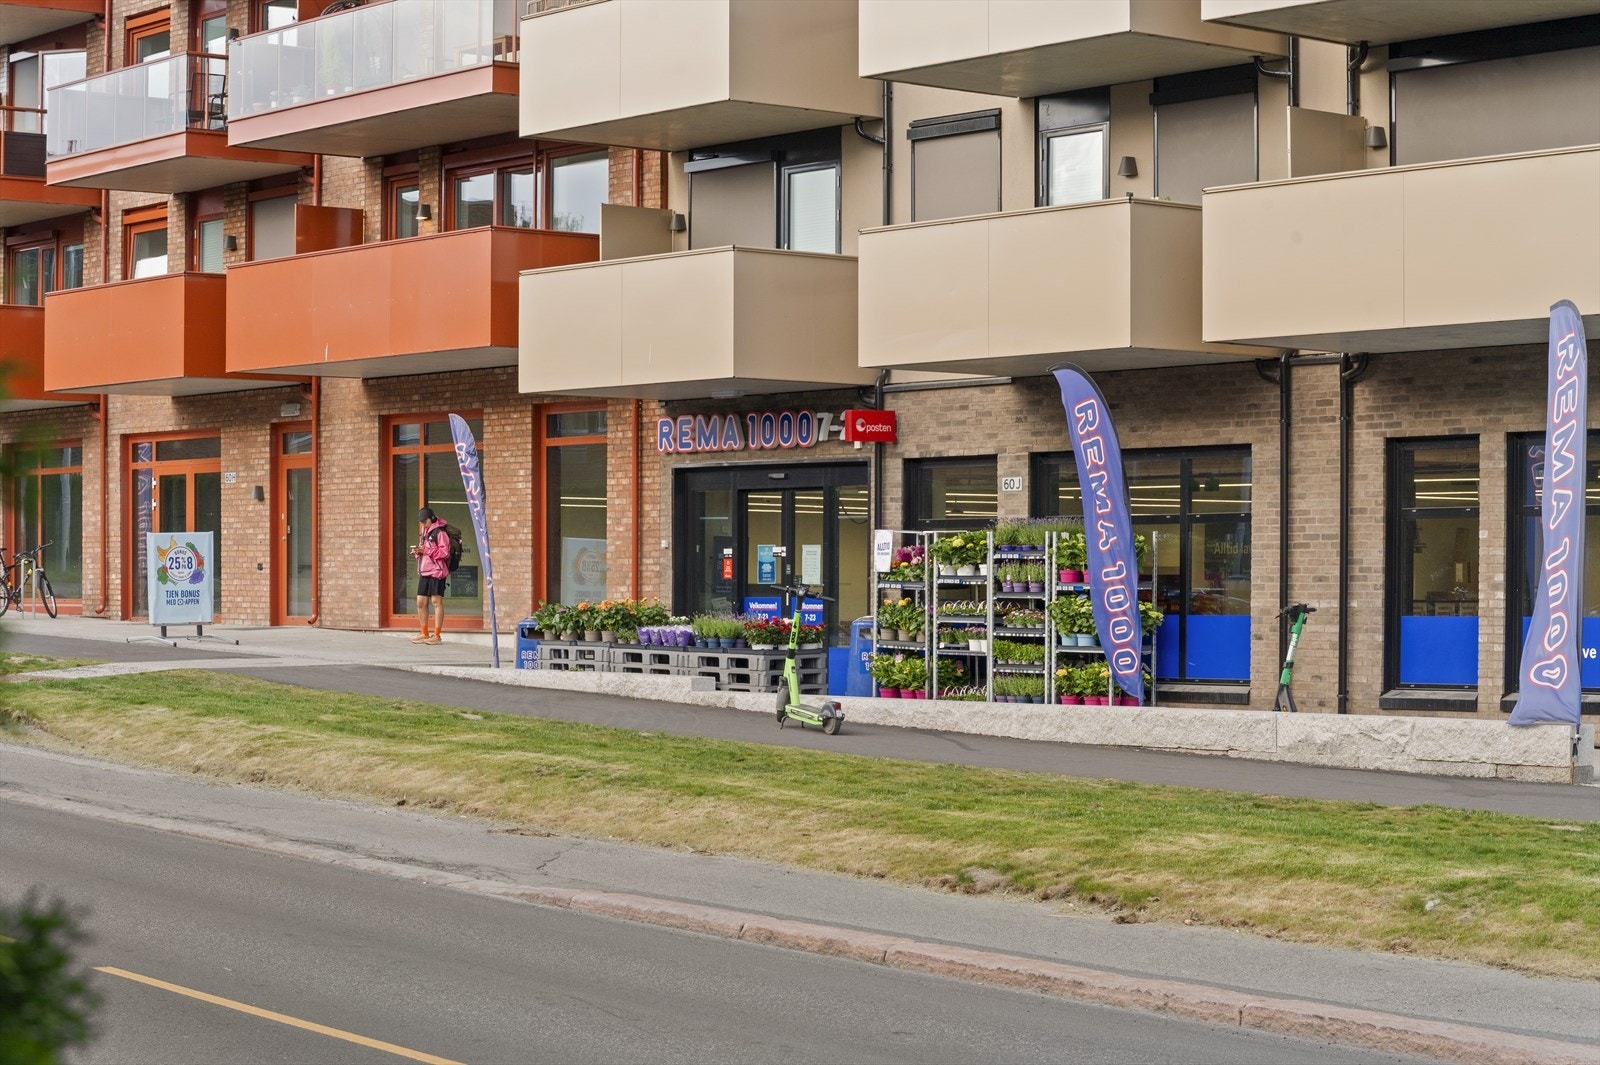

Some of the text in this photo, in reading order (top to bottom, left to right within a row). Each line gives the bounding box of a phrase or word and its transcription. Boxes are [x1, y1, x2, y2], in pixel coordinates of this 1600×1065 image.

[656, 410, 815, 452] REMA 1000
[866, 424, 892, 434] posten
[1550, 331, 1580, 530] REMA
[1004, 478, 1021, 490] 60J
[1074, 398, 1139, 675] REMA 1000
[168, 556, 180, 570] 25
[187, 556, 193, 570] 8
[165, 590, 200, 598] TJEN BONUS
[749, 602, 778, 610] Velkommen!
[805, 614, 816, 622] 7-23
